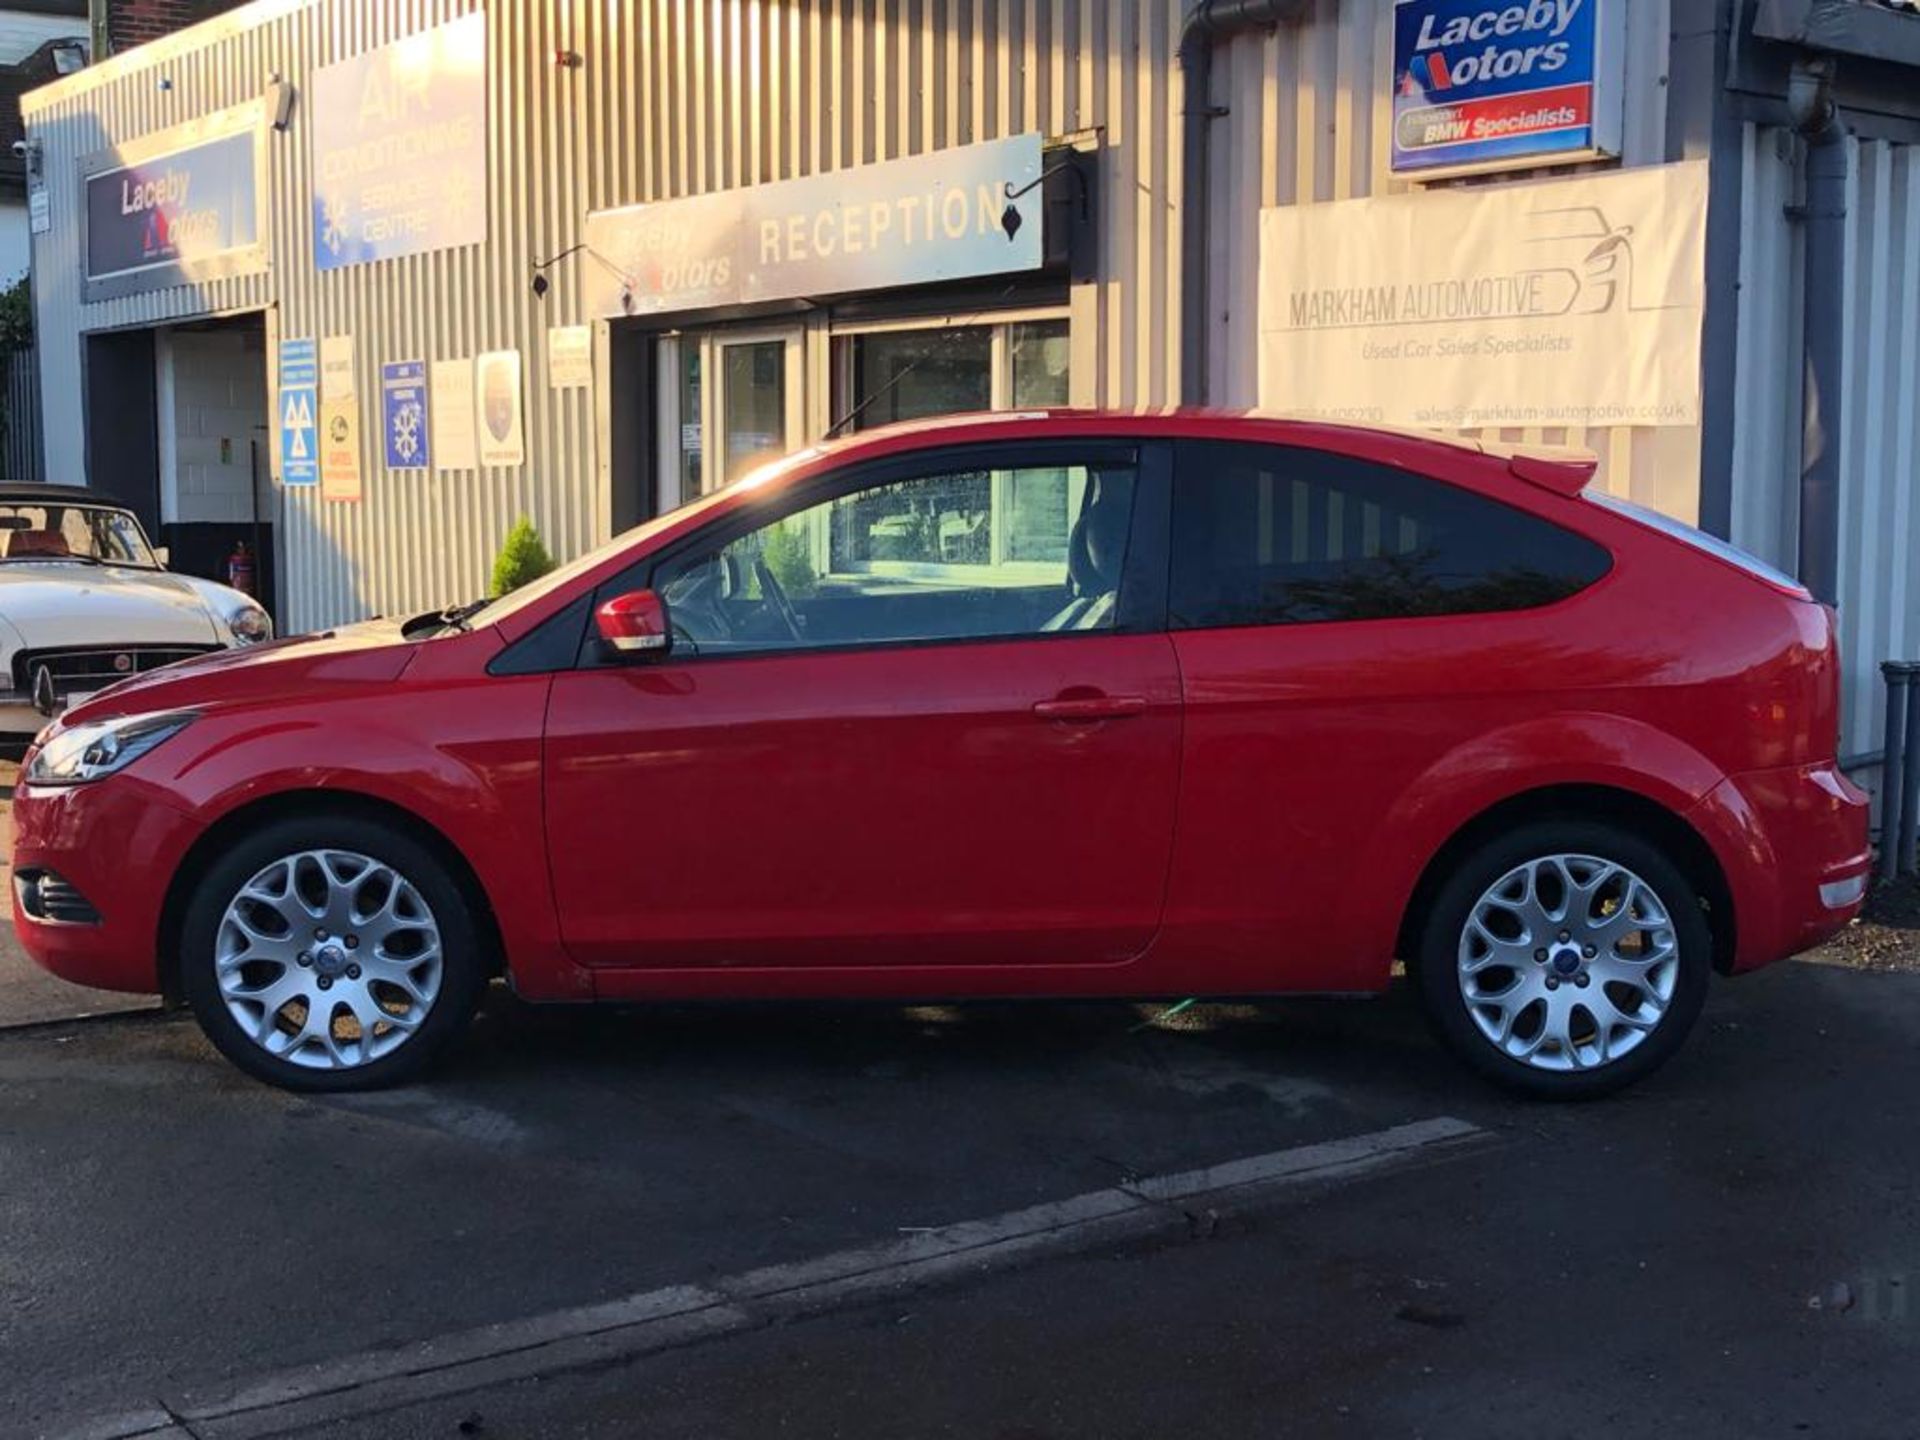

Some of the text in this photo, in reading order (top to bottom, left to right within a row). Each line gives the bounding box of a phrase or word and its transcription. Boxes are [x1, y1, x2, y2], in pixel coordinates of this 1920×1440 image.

[1415, 0, 1582, 51] Laceby
[357, 53, 433, 131] AIR
[323, 112, 474, 182] CONDITIONING
[1423, 106, 1576, 144] BMW Specialists
[121, 166, 191, 216] Laceby
[361, 175, 430, 211] SERVICE
[362, 208, 430, 243] CENTRE
[759, 181, 1004, 265] RECEPTION
[1289, 274, 1544, 327] MARKHAM AUTOMOTIVE
[1362, 333, 1573, 361] Used Car Sales Specialists
